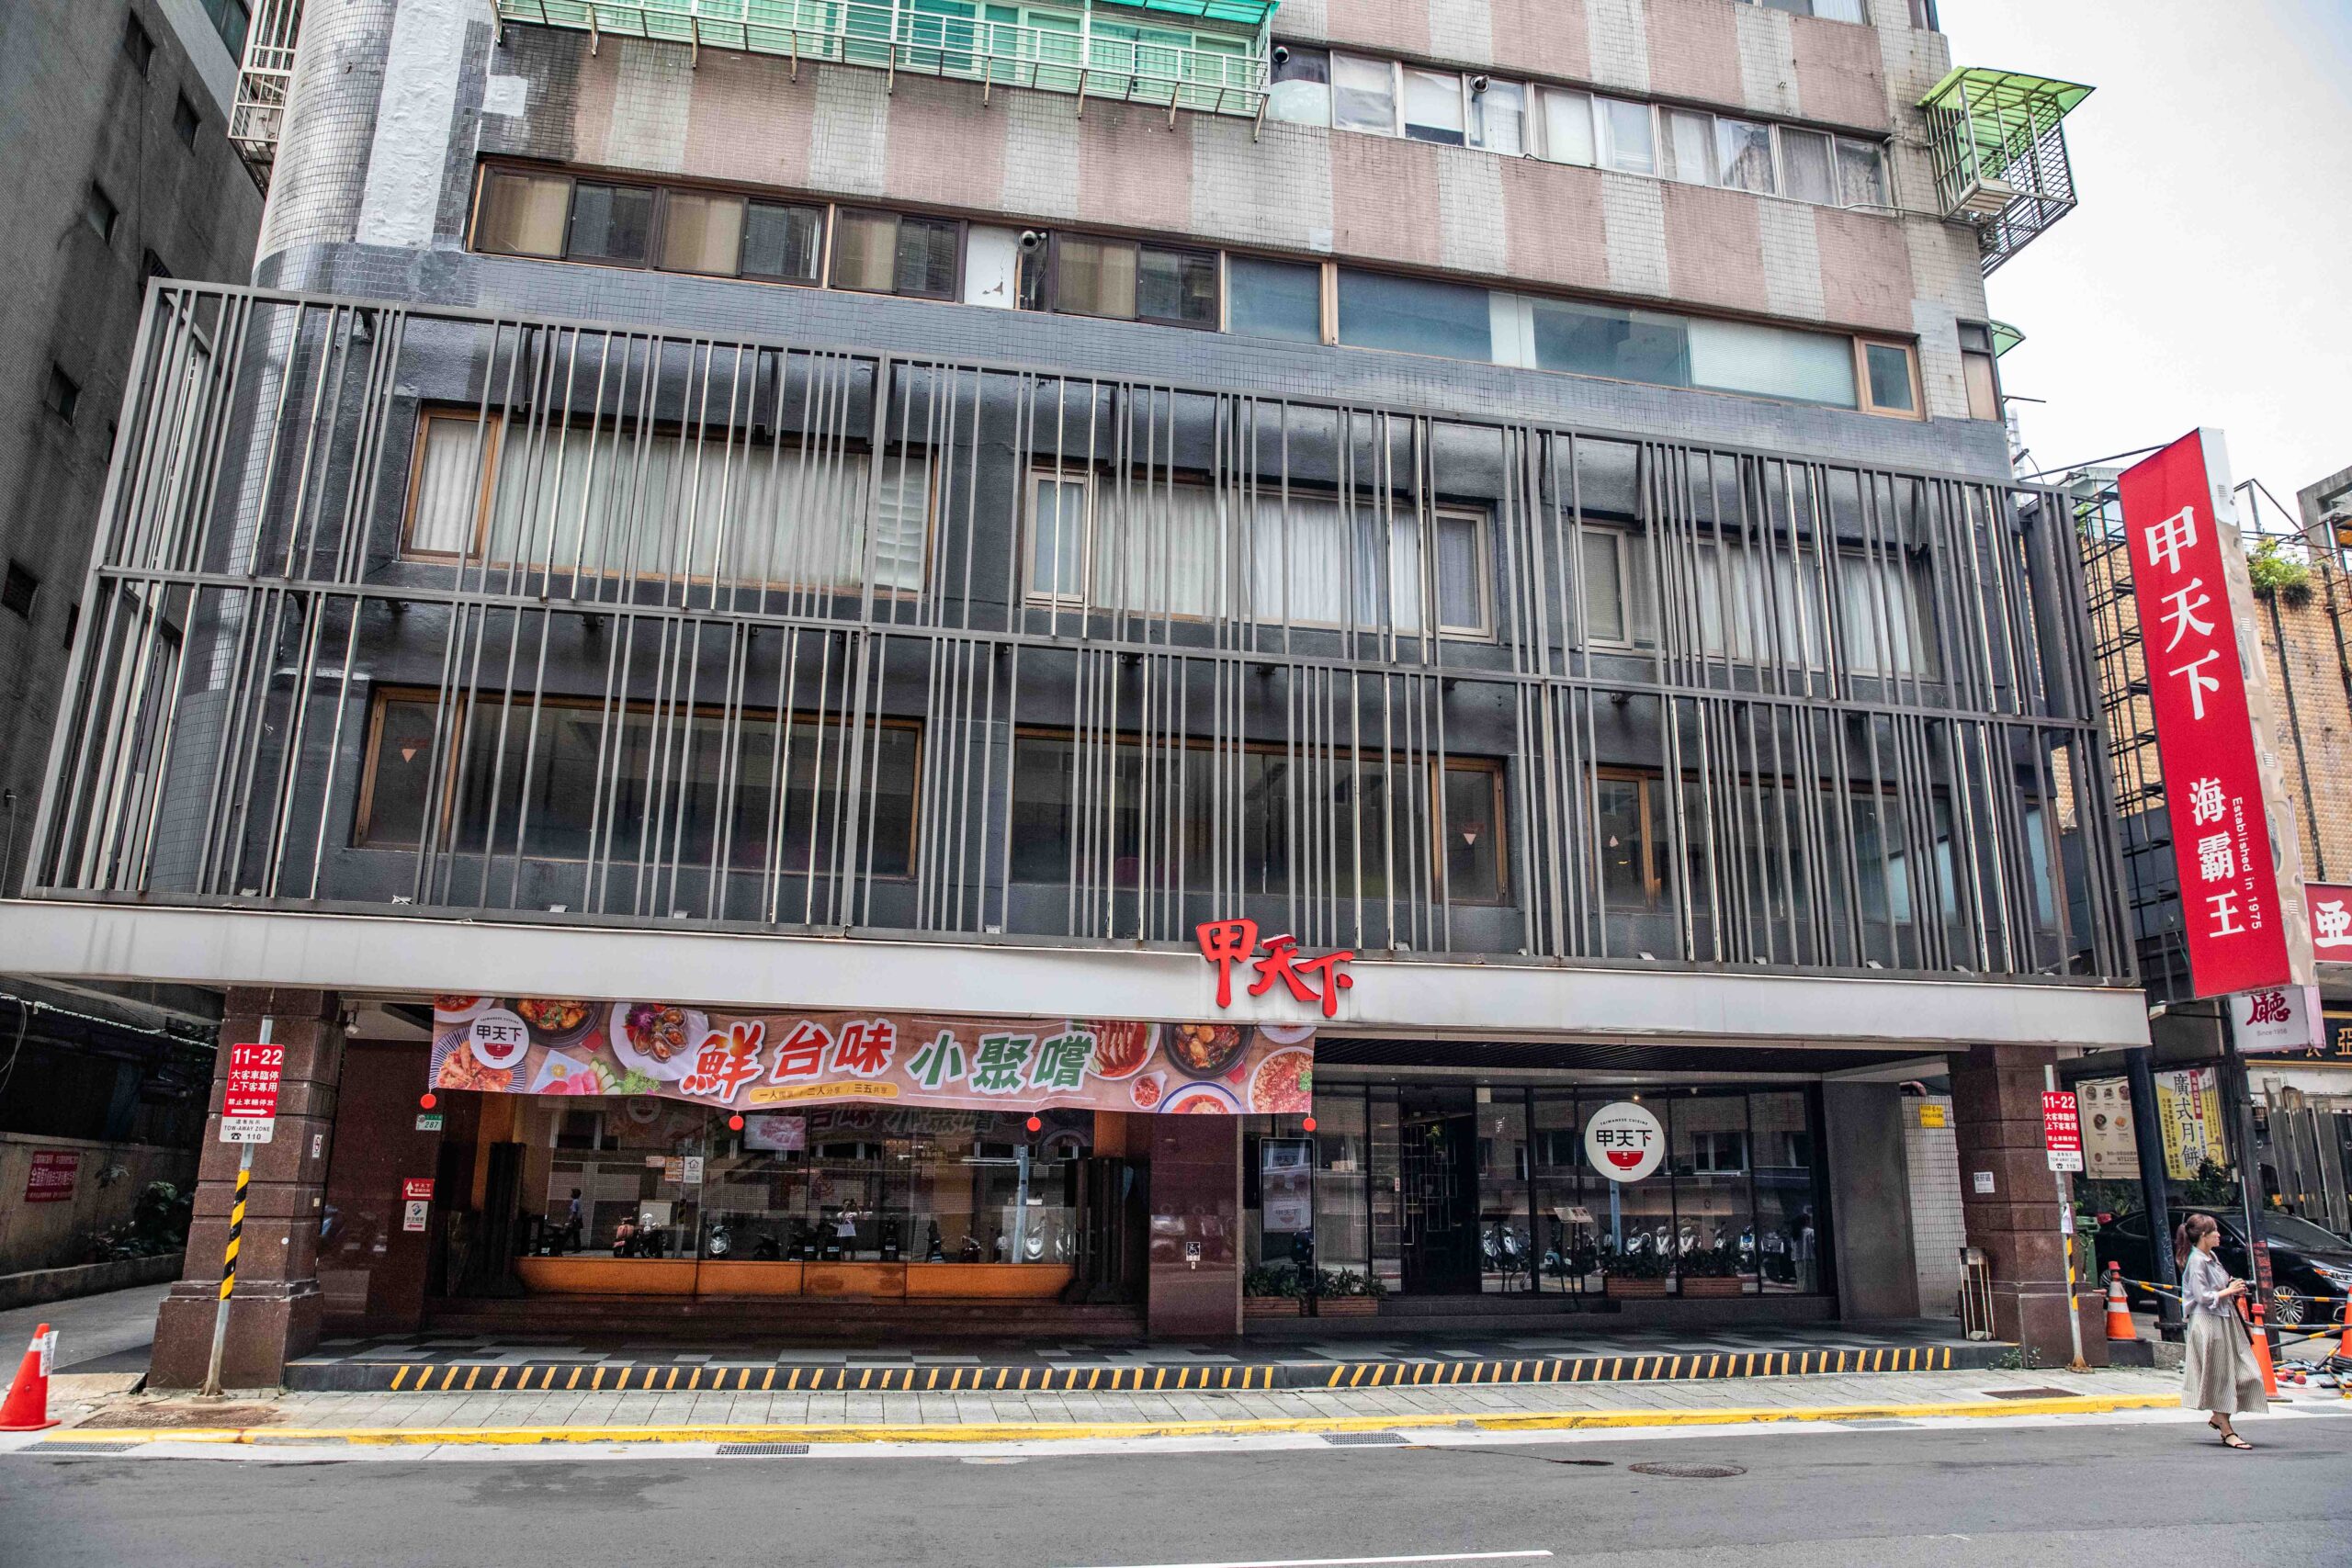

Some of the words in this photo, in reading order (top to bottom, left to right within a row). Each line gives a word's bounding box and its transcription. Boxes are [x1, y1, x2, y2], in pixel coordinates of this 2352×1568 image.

[2144, 505, 2221, 720] 甲天下
[2233, 796, 2253, 873] Established
[2189, 777, 2245, 938] 海霸王
[2245, 876, 2255, 890] in
[2247, 897, 2262, 930] 1975
[1195, 919, 1354, 1018] 甲天下
[476, 1024, 523, 1042] 甲天下
[233, 1048, 283, 1066] 11-22
[682, 1021, 895, 1100] 鮮台味
[908, 1032, 1093, 1091] 小聚嚐
[231, 1069, 279, 1081] 大客車臨停
[229, 1081, 277, 1093] 上下客專用
[228, 1098, 275, 1106] 禁止車輛停放
[2042, 1095, 2076, 1109] 11-22
[424, 1121, 439, 1129] 287
[1600, 1118, 1627, 1126] TAIWANESE
[1628, 1118, 1648, 1126] CUISINE
[2173, 1073, 2199, 1168] 廣式月餅
[1596, 1130, 1653, 1147] 甲天下
